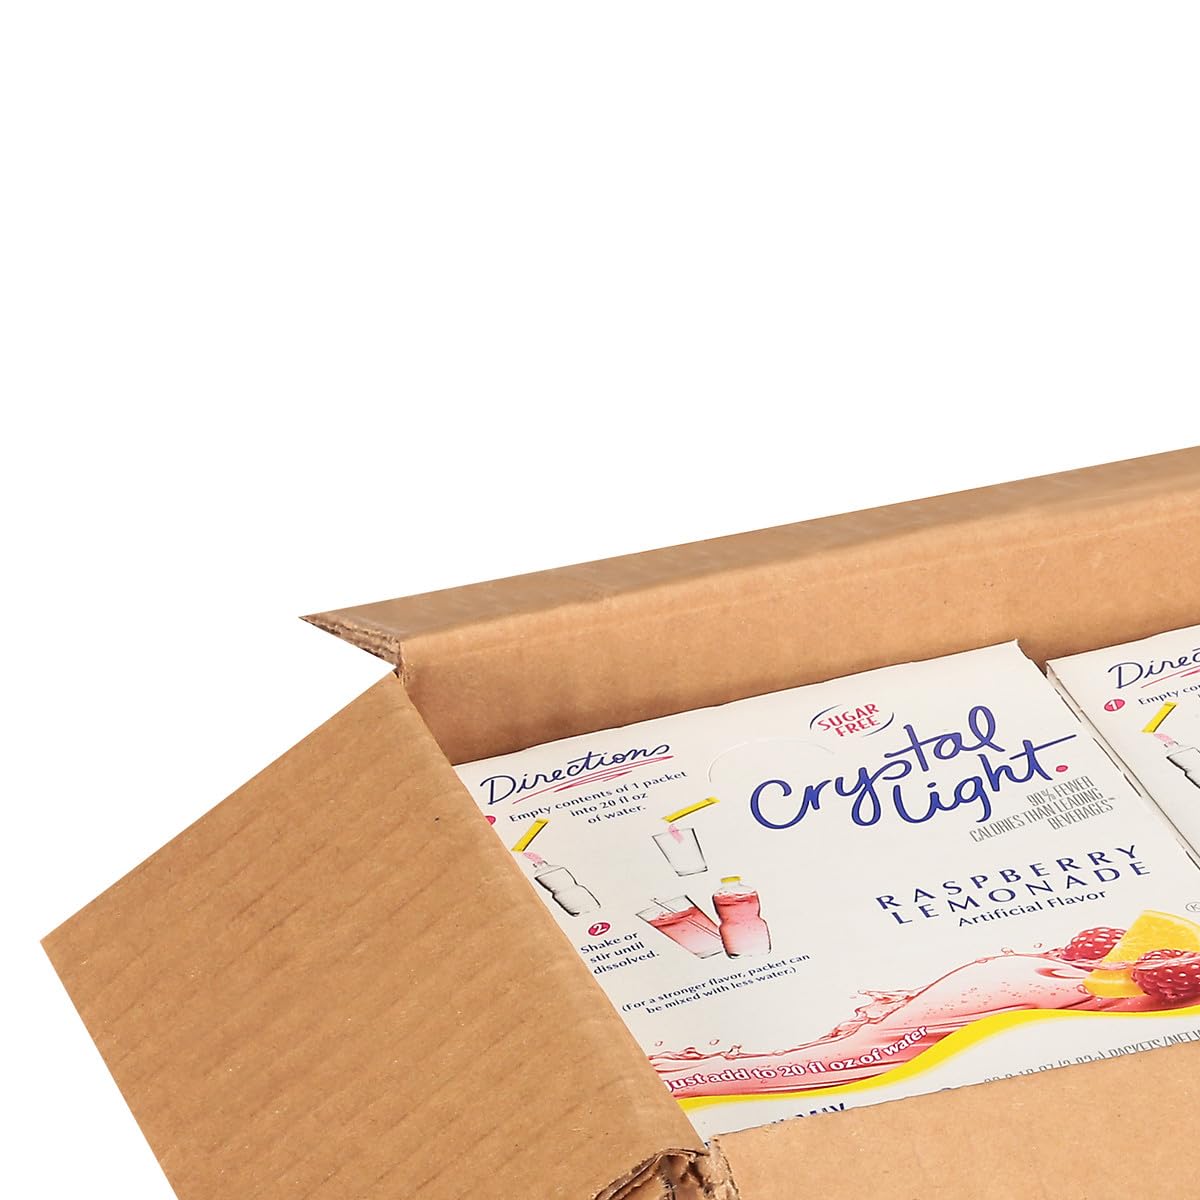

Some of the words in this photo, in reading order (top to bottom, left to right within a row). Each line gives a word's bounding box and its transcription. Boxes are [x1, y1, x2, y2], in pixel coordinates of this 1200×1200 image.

[817, 703, 879, 731] SUGAR
[1138, 690, 1179, 705] Empty
[835, 715, 881, 738] FREE
[480, 745, 670, 805] Directions
[750, 705, 1005, 829] Crystal
[509, 806, 551, 823] Empty
[555, 790, 612, 810] contents
[616, 784, 628, 793] of
[643, 771, 687, 788] packet
[571, 805, 597, 817] into
[602, 800, 616, 809] 20
[619, 795, 630, 804] fl
[1026, 789, 1056, 806] 90%
[1053, 776, 1094, 797] FEWER
[588, 816, 603, 825] of
[605, 806, 647, 819] water.
[969, 815, 1025, 842] CALORIES
[1022, 804, 1056, 824] THAN
[1053, 788, 1103, 812] LEADING
[876, 844, 1139, 911] RASPBERRY
[892, 861, 1151, 925] LEMONADE
[958, 900, 1044, 927] Artificial
[1047, 888, 1106, 909] Flavor
[580, 939, 620, 954] Shake
[624, 932, 638, 940] or
[590, 952, 611, 963] stir
[614, 941, 645, 955] until
[594, 950, 660, 974] dissolved.
[622, 1000, 645, 1012] (For
[658, 982, 706, 1001] stronger
[709, 973, 746, 986] flavor,
[748, 960, 788, 977] packet
[789, 954, 810, 963] can
[645, 1005, 662, 1014] be
[665, 993, 701, 1010] mixed
[703, 985, 729, 997] with
[731, 978, 754, 990] less
[755, 967, 796, 982] water.)
[708, 1067, 750, 1084] add
[752, 1066, 777, 1080] to
[778, 1064, 805, 1077] 20
[807, 1062, 825, 1075] fl
[828, 1058, 856, 1071] oz
[860, 1047, 881, 1065] of
[881, 1026, 928, 1056] water
